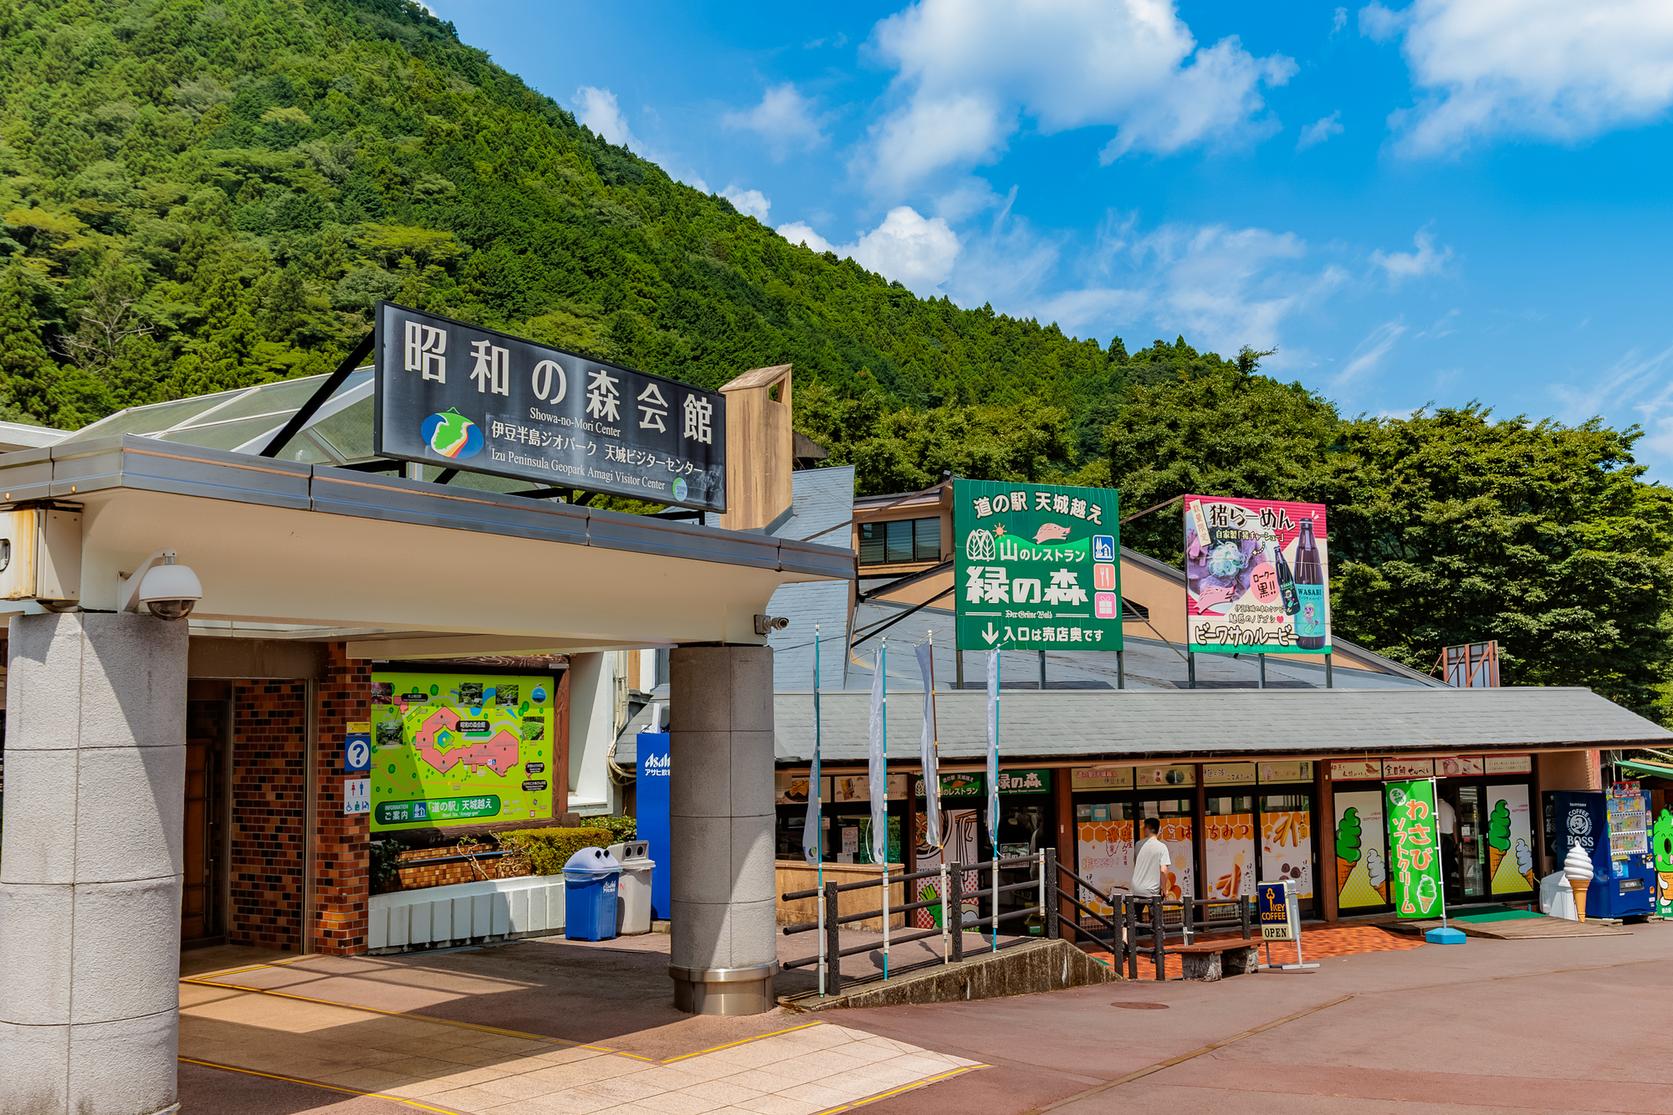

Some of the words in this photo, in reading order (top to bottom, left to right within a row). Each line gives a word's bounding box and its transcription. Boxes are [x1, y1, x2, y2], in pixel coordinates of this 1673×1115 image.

[404, 320, 713, 445] 昭和の森会館
[529, 407, 594, 432] Showa-no-Mori
[595, 421, 621, 437] Center
[491, 420, 597, 456] 伊豆半島ジオパーク
[604, 443, 703, 475] 天城ビジターセンター
[492, 447, 506, 461] Izu
[508, 451, 549, 469] Peninsula
[551, 459, 585, 476] Geopark
[587, 466, 613, 483] Amagi
[615, 471, 640, 486] Visitor
[641, 476, 666, 490] Center
[973, 491, 1028, 519] 道の駅
[1035, 491, 1104, 526] 天城越え
[1210, 504, 1296, 531] 猪らーめん
[1000, 539, 1085, 562] 山のレストラン
[966, 565, 1089, 606] 緑の森
[1003, 626, 1104, 642] 入口は売店奥です
[1194, 622, 1300, 647] ビーワサのルービー
[645, 753, 670, 768] Asah
[940, 786, 979, 796] のレストラン
[384, 810, 408, 821] ご案内
[1568, 809, 1590, 818] COFFEE
[1405, 799, 1433, 871] わさび
[1567, 835, 1594, 846] BOSS
[1392, 817, 1416, 913] ソフトクリーム
[1261, 912, 1286, 920] COFFEE
[1264, 928, 1287, 938] OPEN
